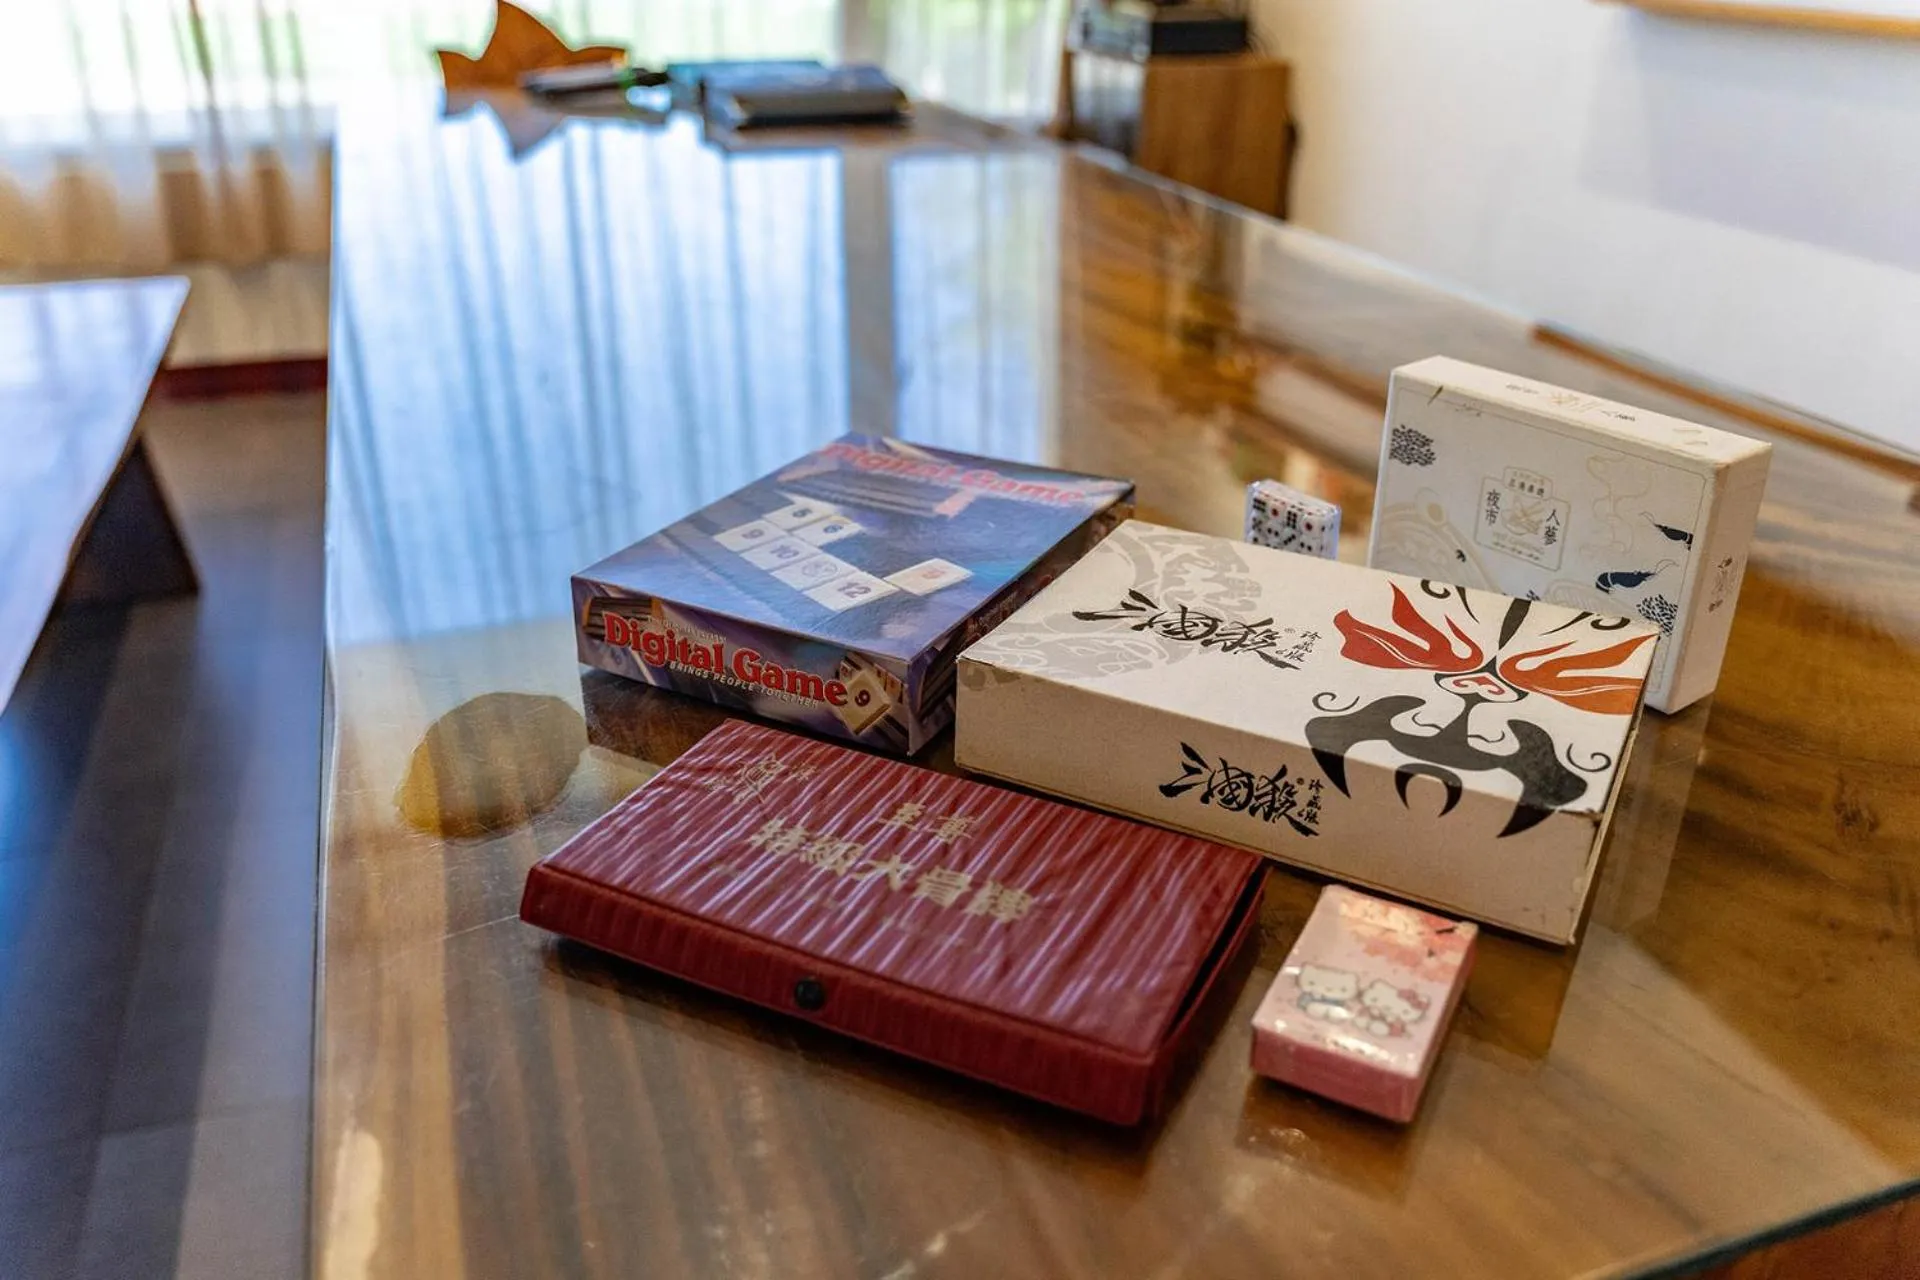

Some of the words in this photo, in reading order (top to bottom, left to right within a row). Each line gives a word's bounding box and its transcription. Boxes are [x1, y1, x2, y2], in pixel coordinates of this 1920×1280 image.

[837, 581, 872, 599] 12
[602, 611, 726, 674] Digital
[732, 647, 849, 707] Game
[669, 660, 709, 679] BRINGS
[713, 673, 756, 692] PEOPLE
[760, 685, 820, 709] TOGETHER
